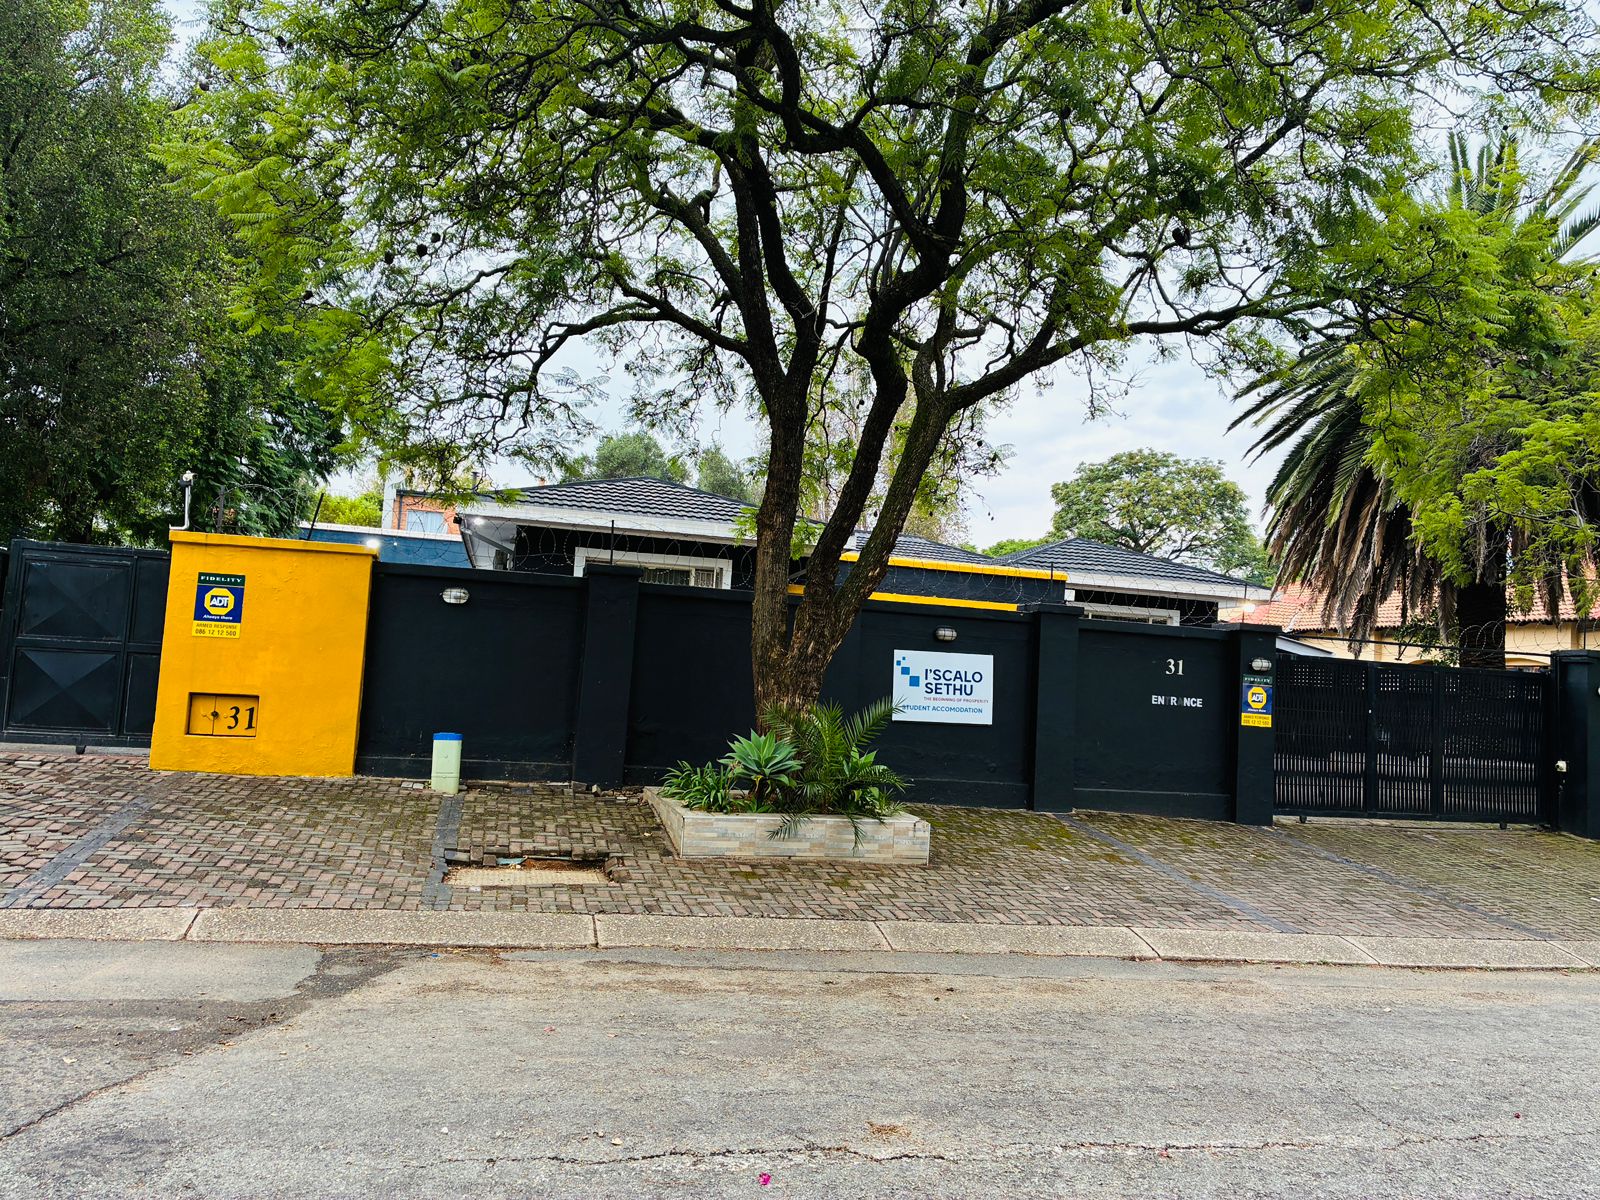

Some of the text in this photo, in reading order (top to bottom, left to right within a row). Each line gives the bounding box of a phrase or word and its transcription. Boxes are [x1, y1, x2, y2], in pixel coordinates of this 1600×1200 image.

[210, 596, 229, 607] ADT
[1165, 659, 1184, 675] 31
[924, 668, 983, 683] I'SCALO
[924, 682, 974, 696] SETHU
[1251, 693, 1264, 702] ADT
[932, 705, 983, 713] ACCOMODATION
[227, 706, 256, 730] 31
